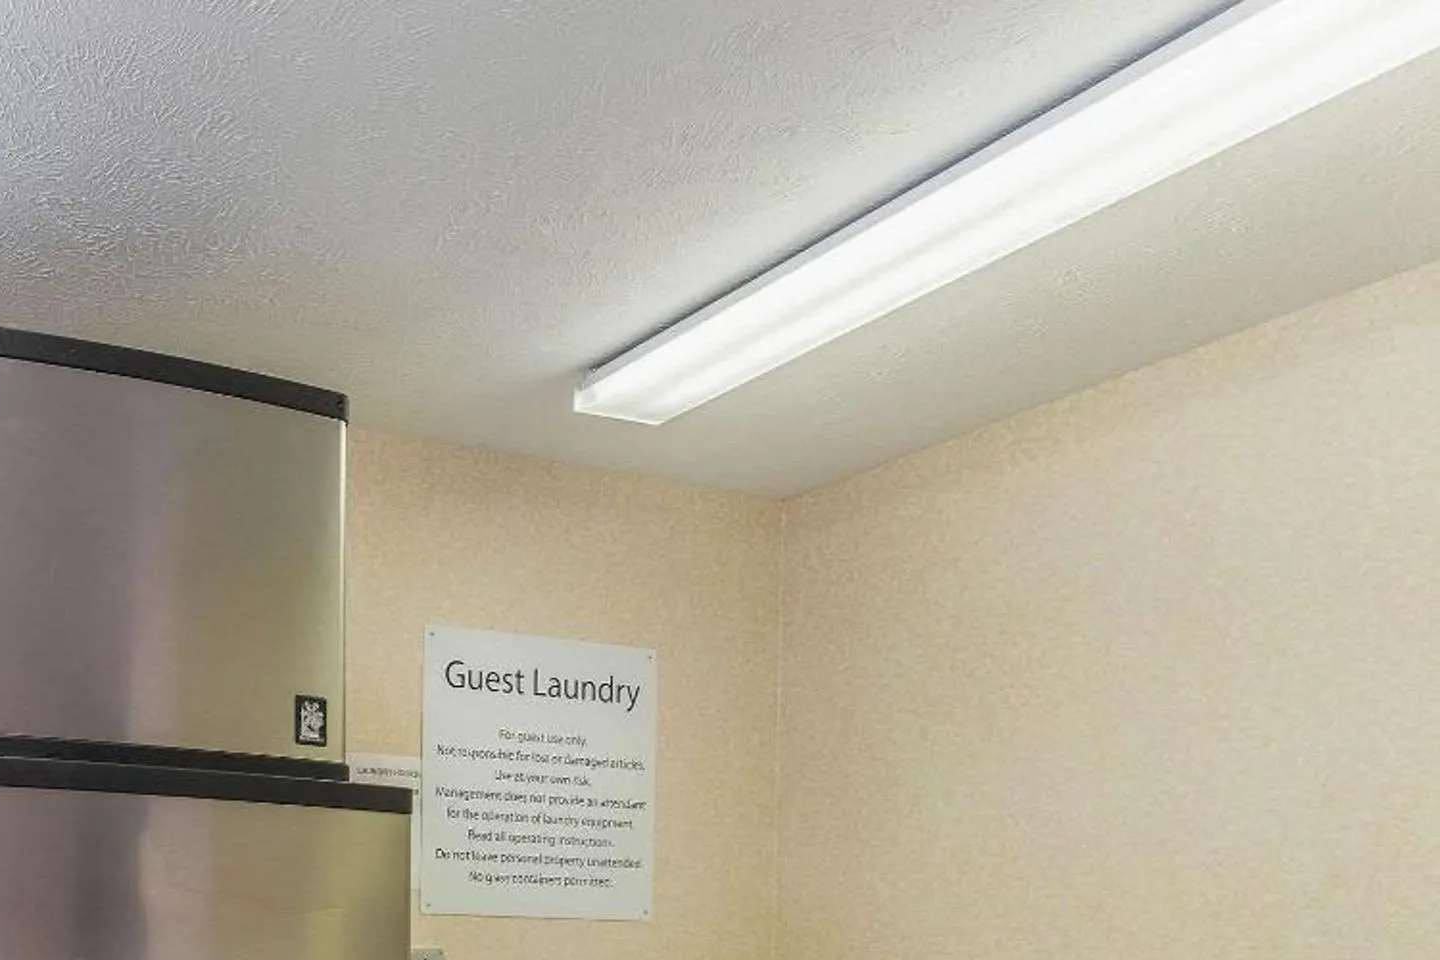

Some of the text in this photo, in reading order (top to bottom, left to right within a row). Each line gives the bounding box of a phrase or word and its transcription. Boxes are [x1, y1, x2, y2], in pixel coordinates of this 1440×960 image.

[444, 659, 642, 712] Guest Laundry
[499, 729, 515, 741] For
[547, 735, 564, 744] use
[516, 750, 531, 762] for
[495, 770, 512, 781] Use
[514, 772, 524, 782] at
[525, 774, 549, 786] your
[435, 786, 503, 801] Management
[447, 806, 461, 819] for
[462, 808, 480, 820] the
[481, 811, 530, 823] operation
[531, 813, 542, 823] of
[543, 813, 579, 828] laundry
[468, 829, 493, 842] Read
[495, 830, 507, 842] all
[508, 833, 556, 847] operating
[435, 848, 451, 860] Do
[452, 850, 471, 861] not
[472, 850, 498, 862] leave
[500, 853, 543, 865] personal
[544, 855, 586, 869] property
